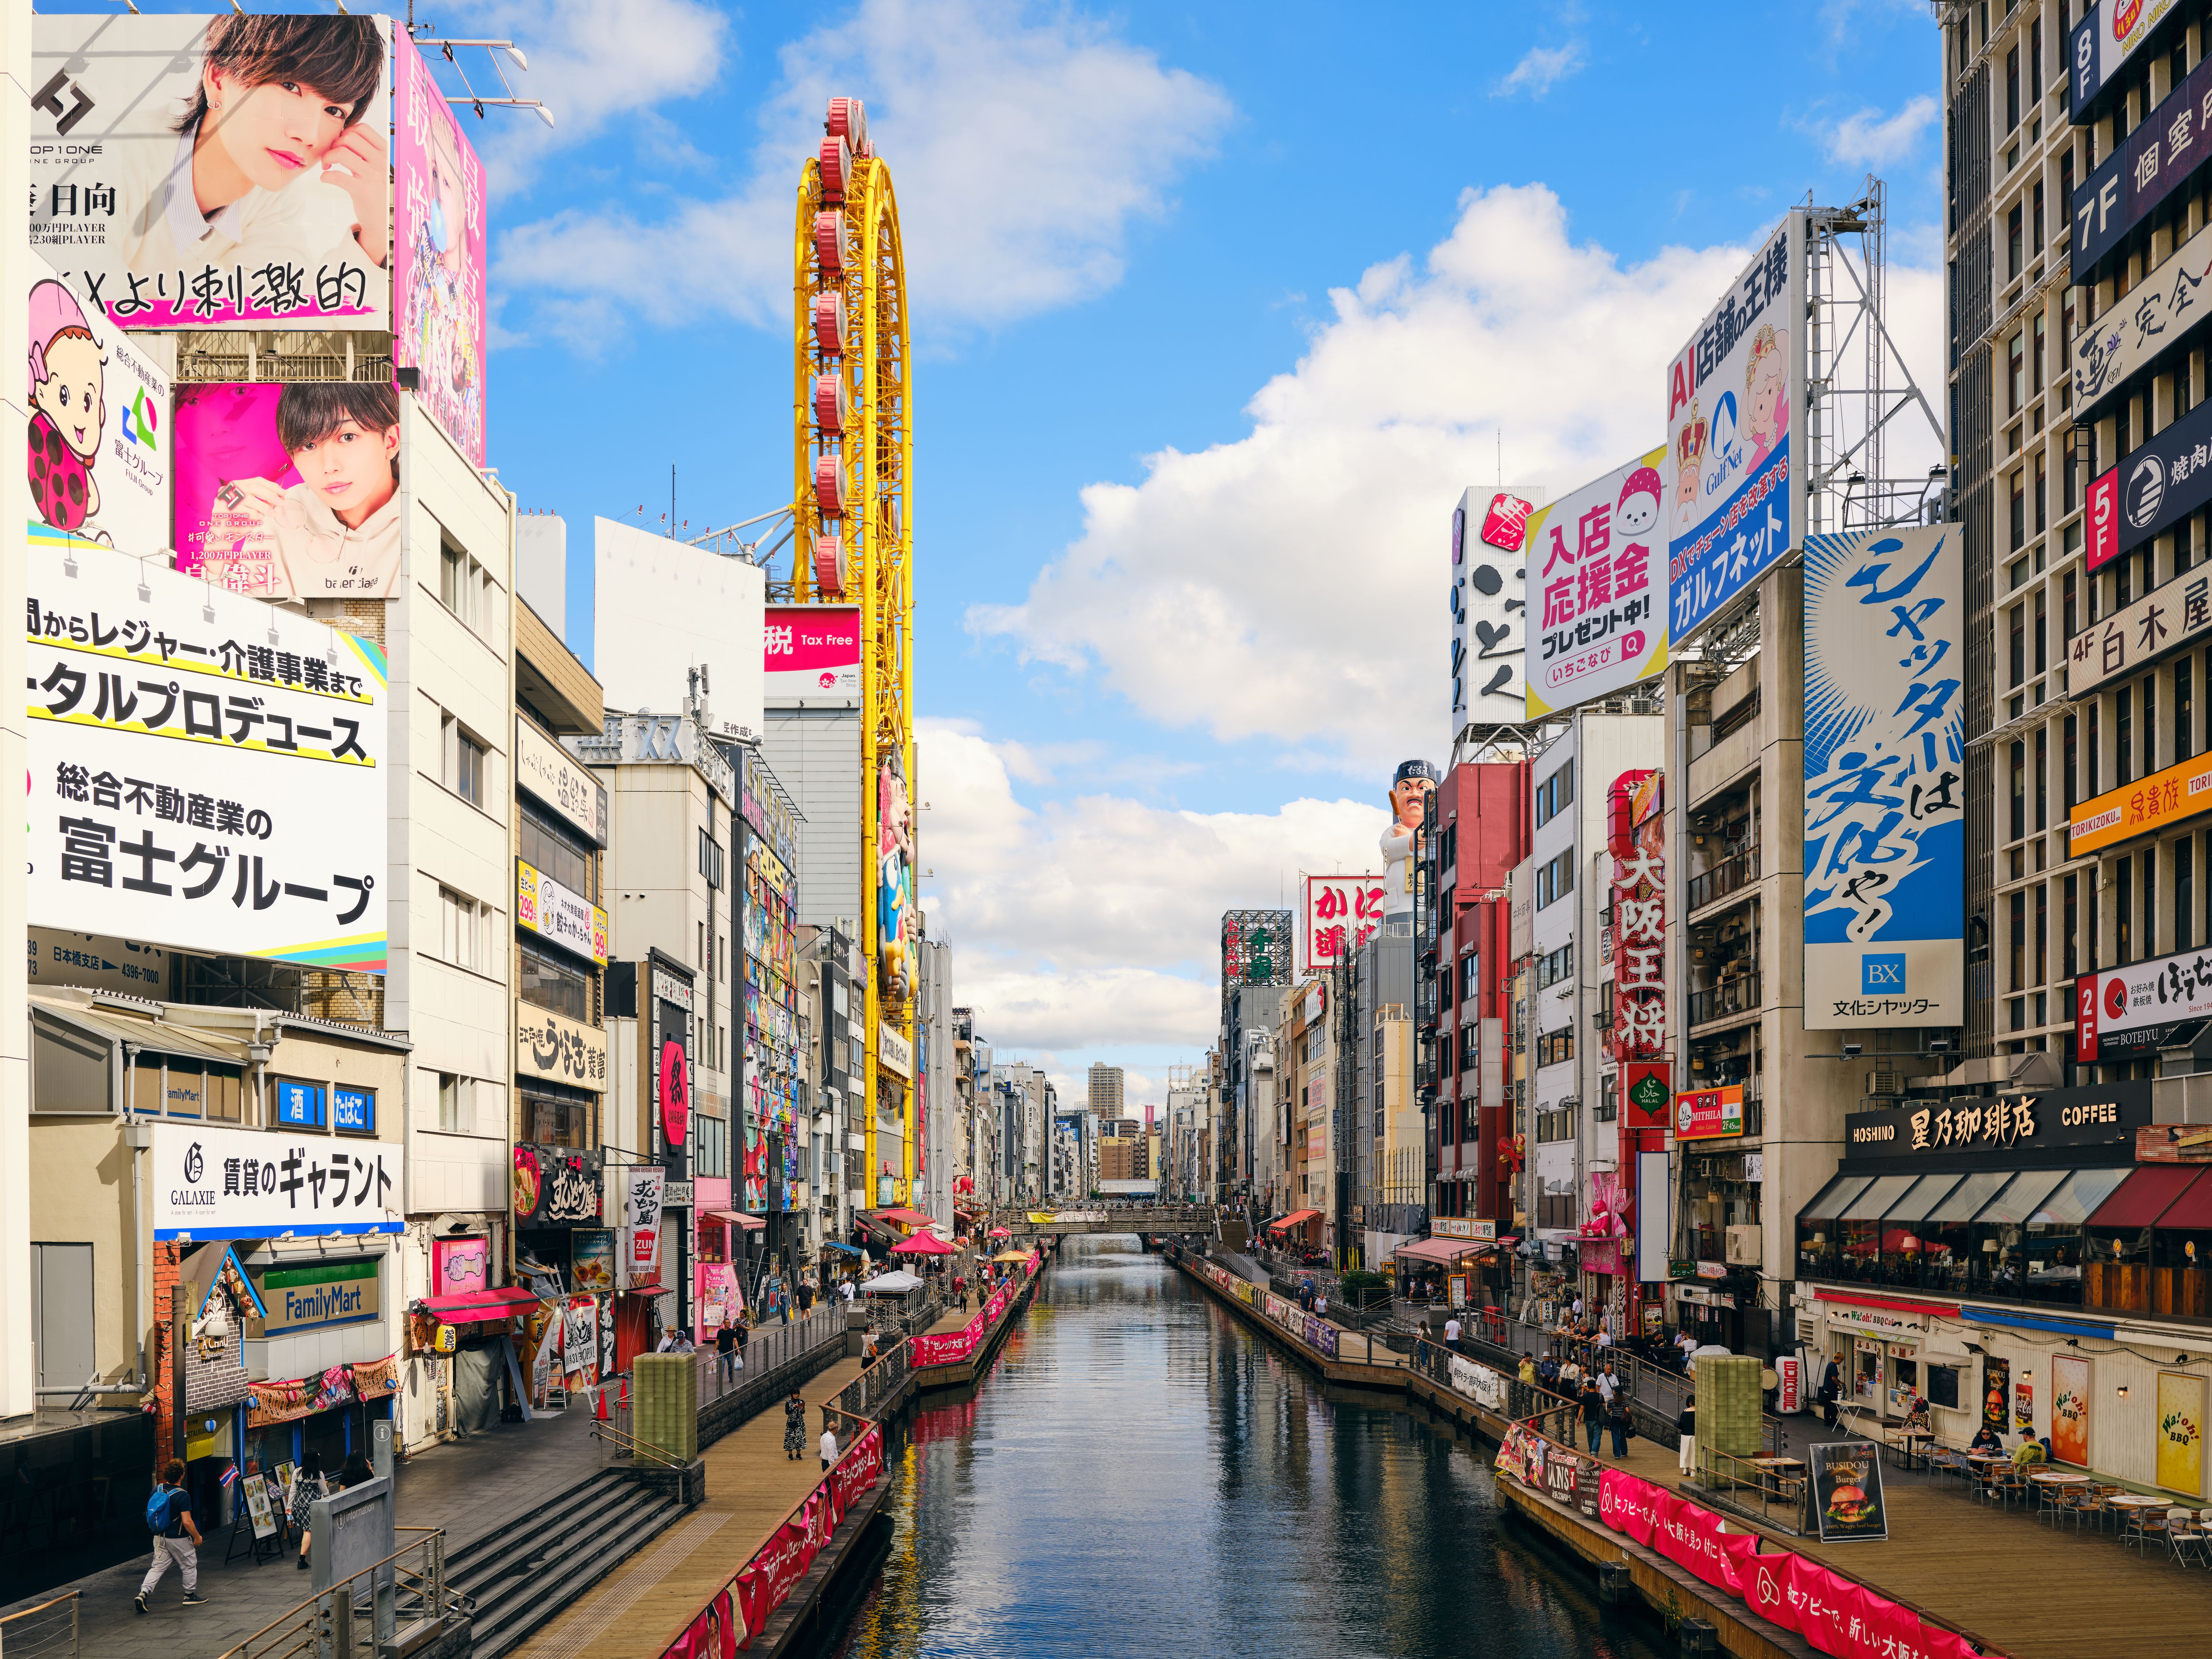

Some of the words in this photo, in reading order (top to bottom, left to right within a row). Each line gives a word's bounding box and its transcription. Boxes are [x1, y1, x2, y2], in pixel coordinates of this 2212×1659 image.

[2123, 22, 2145, 56] NIKO
[52, 182, 116, 216] 日向
[2078, 174, 2118, 251] 7F
[1669, 231, 1788, 423] AI店舗の王様
[116, 345, 164, 397] 総合不動産業の
[2106, 362, 2122, 387] REN
[114, 440, 164, 486] 富士グループ
[125, 469, 137, 481] FUJI
[139, 479, 153, 496] Group
[1670, 453, 1789, 587] DXでチェーン店を改革する
[2094, 482, 2111, 558] 5F
[1543, 502, 1611, 579] 入店
[190, 551, 271, 561] 1,200万円PLAYER
[1674, 502, 1784, 633] ガルフネット
[1543, 542, 1650, 632] 応援金
[2103, 576, 2211, 676] 白木屋
[801, 634, 823, 646] Tax
[827, 634, 853, 646] Free
[2073, 631, 2094, 662] 4F
[1552, 646, 1611, 682] いちごなび
[521, 740, 555, 786] しゃぶしゃぶ
[1407, 765, 1429, 776] だるま
[56, 761, 273, 840] 総合不動産業の
[558, 767, 588, 823] 温野菜
[597, 805, 606, 822] 17:00
[2071, 811, 2116, 838] TORIKIZOKU
[60, 815, 375, 926] 富士グループ
[521, 876, 536, 894] 生ビール
[561, 898, 584, 921] ネオ大衆居酒屋
[1315, 886, 1384, 919] かに
[1513, 899, 1530, 922] 中和商事
[556, 911, 591, 945] 餃子のかっちゃん
[594, 918, 607, 934] ハイボール
[53, 946, 99, 971] 日本橋支店
[1227, 919, 1240, 977] お好み焼
[1250, 927, 1272, 979] 千房
[1613, 849, 1666, 1050] 大阪王将
[122, 962, 159, 985] 4396-7000
[1868, 964, 1900, 984] BX
[2131, 981, 2155, 995] お好み焼
[2133, 994, 2152, 1007] 鉄板焼
[2083, 988, 2093, 1050] 2F
[2120, 1028, 2157, 1046] BOTEJYU
[291, 1088, 303, 1119] 酒
[335, 1093, 363, 1124] たばこ
[1692, 1109, 1721, 1122] MITHILA
[2062, 1103, 2117, 1126] COFFEE
[1722, 1120, 1729, 1130] 2F
[1853, 1124, 1894, 1143] HOSHINO
[1911, 1094, 2036, 1151] 星乃珈琲店
[223, 1146, 392, 1209] 賃貸のギャラント
[171, 1190, 216, 1205] GALAXIE
[1475, 1224, 1492, 1236] 串カツ専門店
[286, 1285, 361, 1321] FamilyMart
[1618, 1282, 1626, 1307] NINJA
[1873, 1315, 1884, 1326] BBQ
[205, 1349, 226, 1359] Restaurant
[1783, 1361, 1798, 1411] BURGER
[1987, 1368, 2005, 1379] BUSIDOU
[1990, 1380, 2001, 1390] Burger
[2061, 1408, 2078, 1421] BBQ
[2169, 1432, 2190, 1447] BBQ
[1826, 1460, 1869, 1470] BUSIDOU
[1835, 1475, 1861, 1485] Burger
[346, 1502, 375, 1523] information
